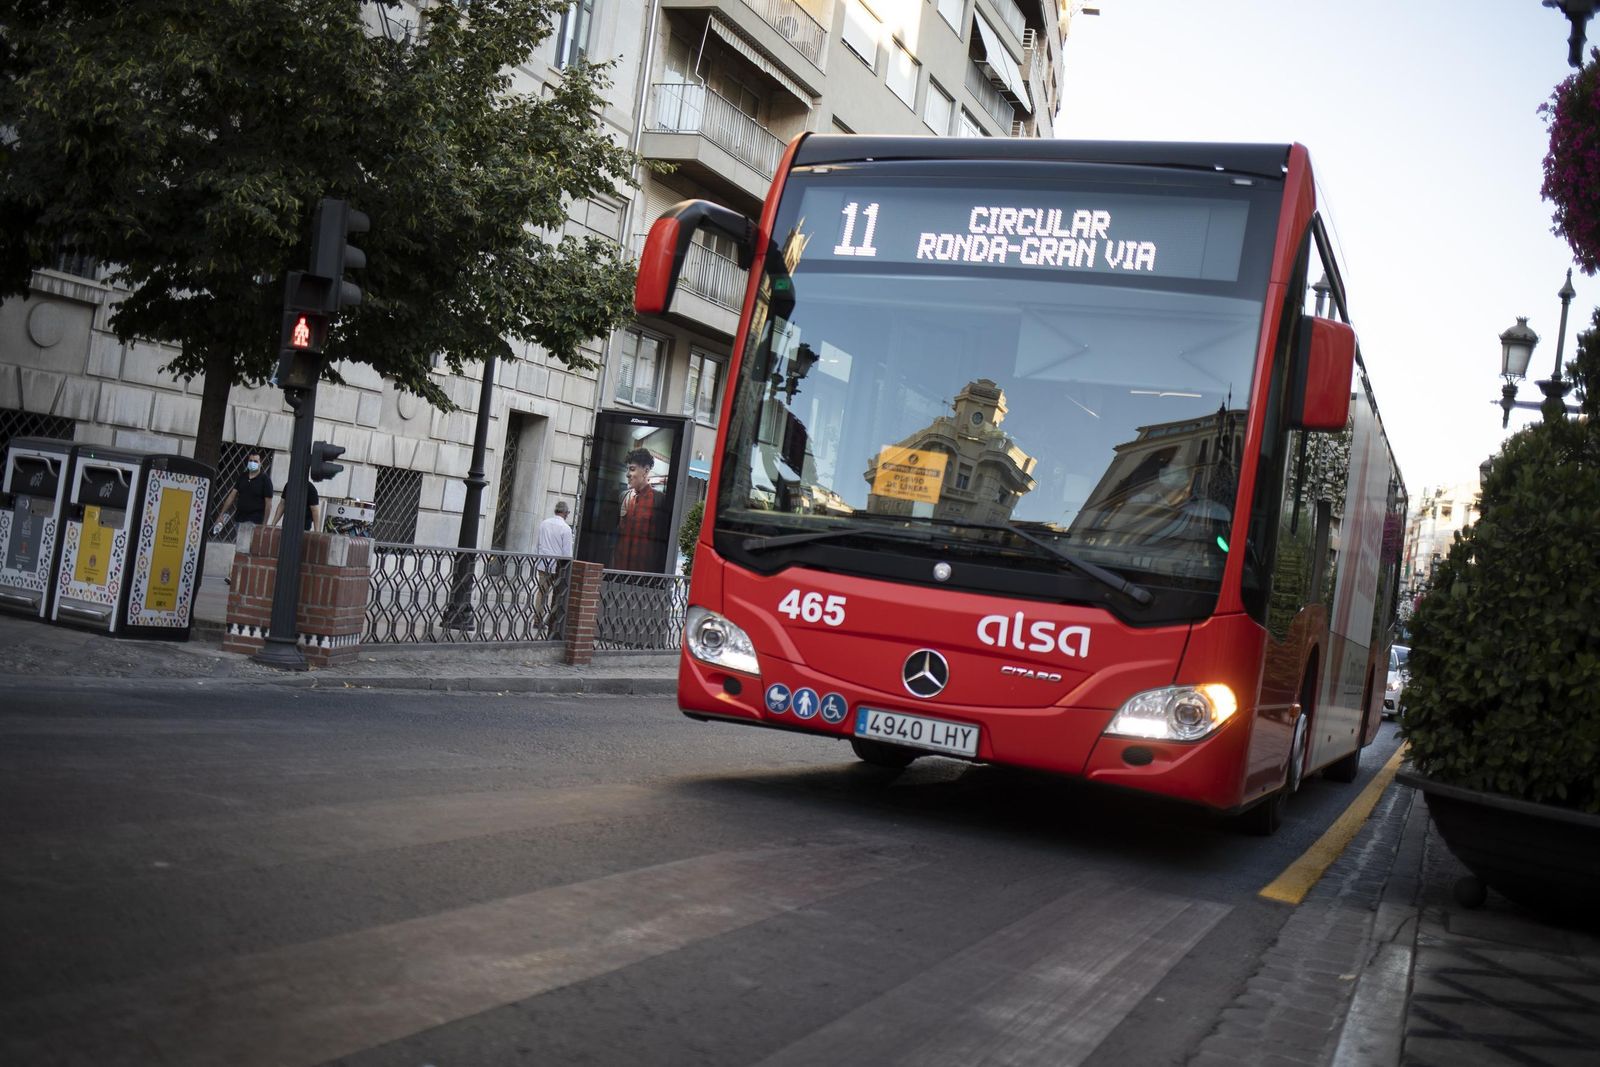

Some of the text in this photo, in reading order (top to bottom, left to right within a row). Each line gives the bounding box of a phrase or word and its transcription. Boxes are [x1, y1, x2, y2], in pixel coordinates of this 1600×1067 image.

[833, 202, 880, 257] 11
[968, 206, 1111, 239] CIRCULAR
[916, 232, 1156, 272] RONDA-GRAN VIA
[778, 589, 847, 627] 465
[976, 611, 1091, 659] alsa
[1000, 665, 1062, 682] CITARO
[869, 713, 973, 749] 4940 LHY
